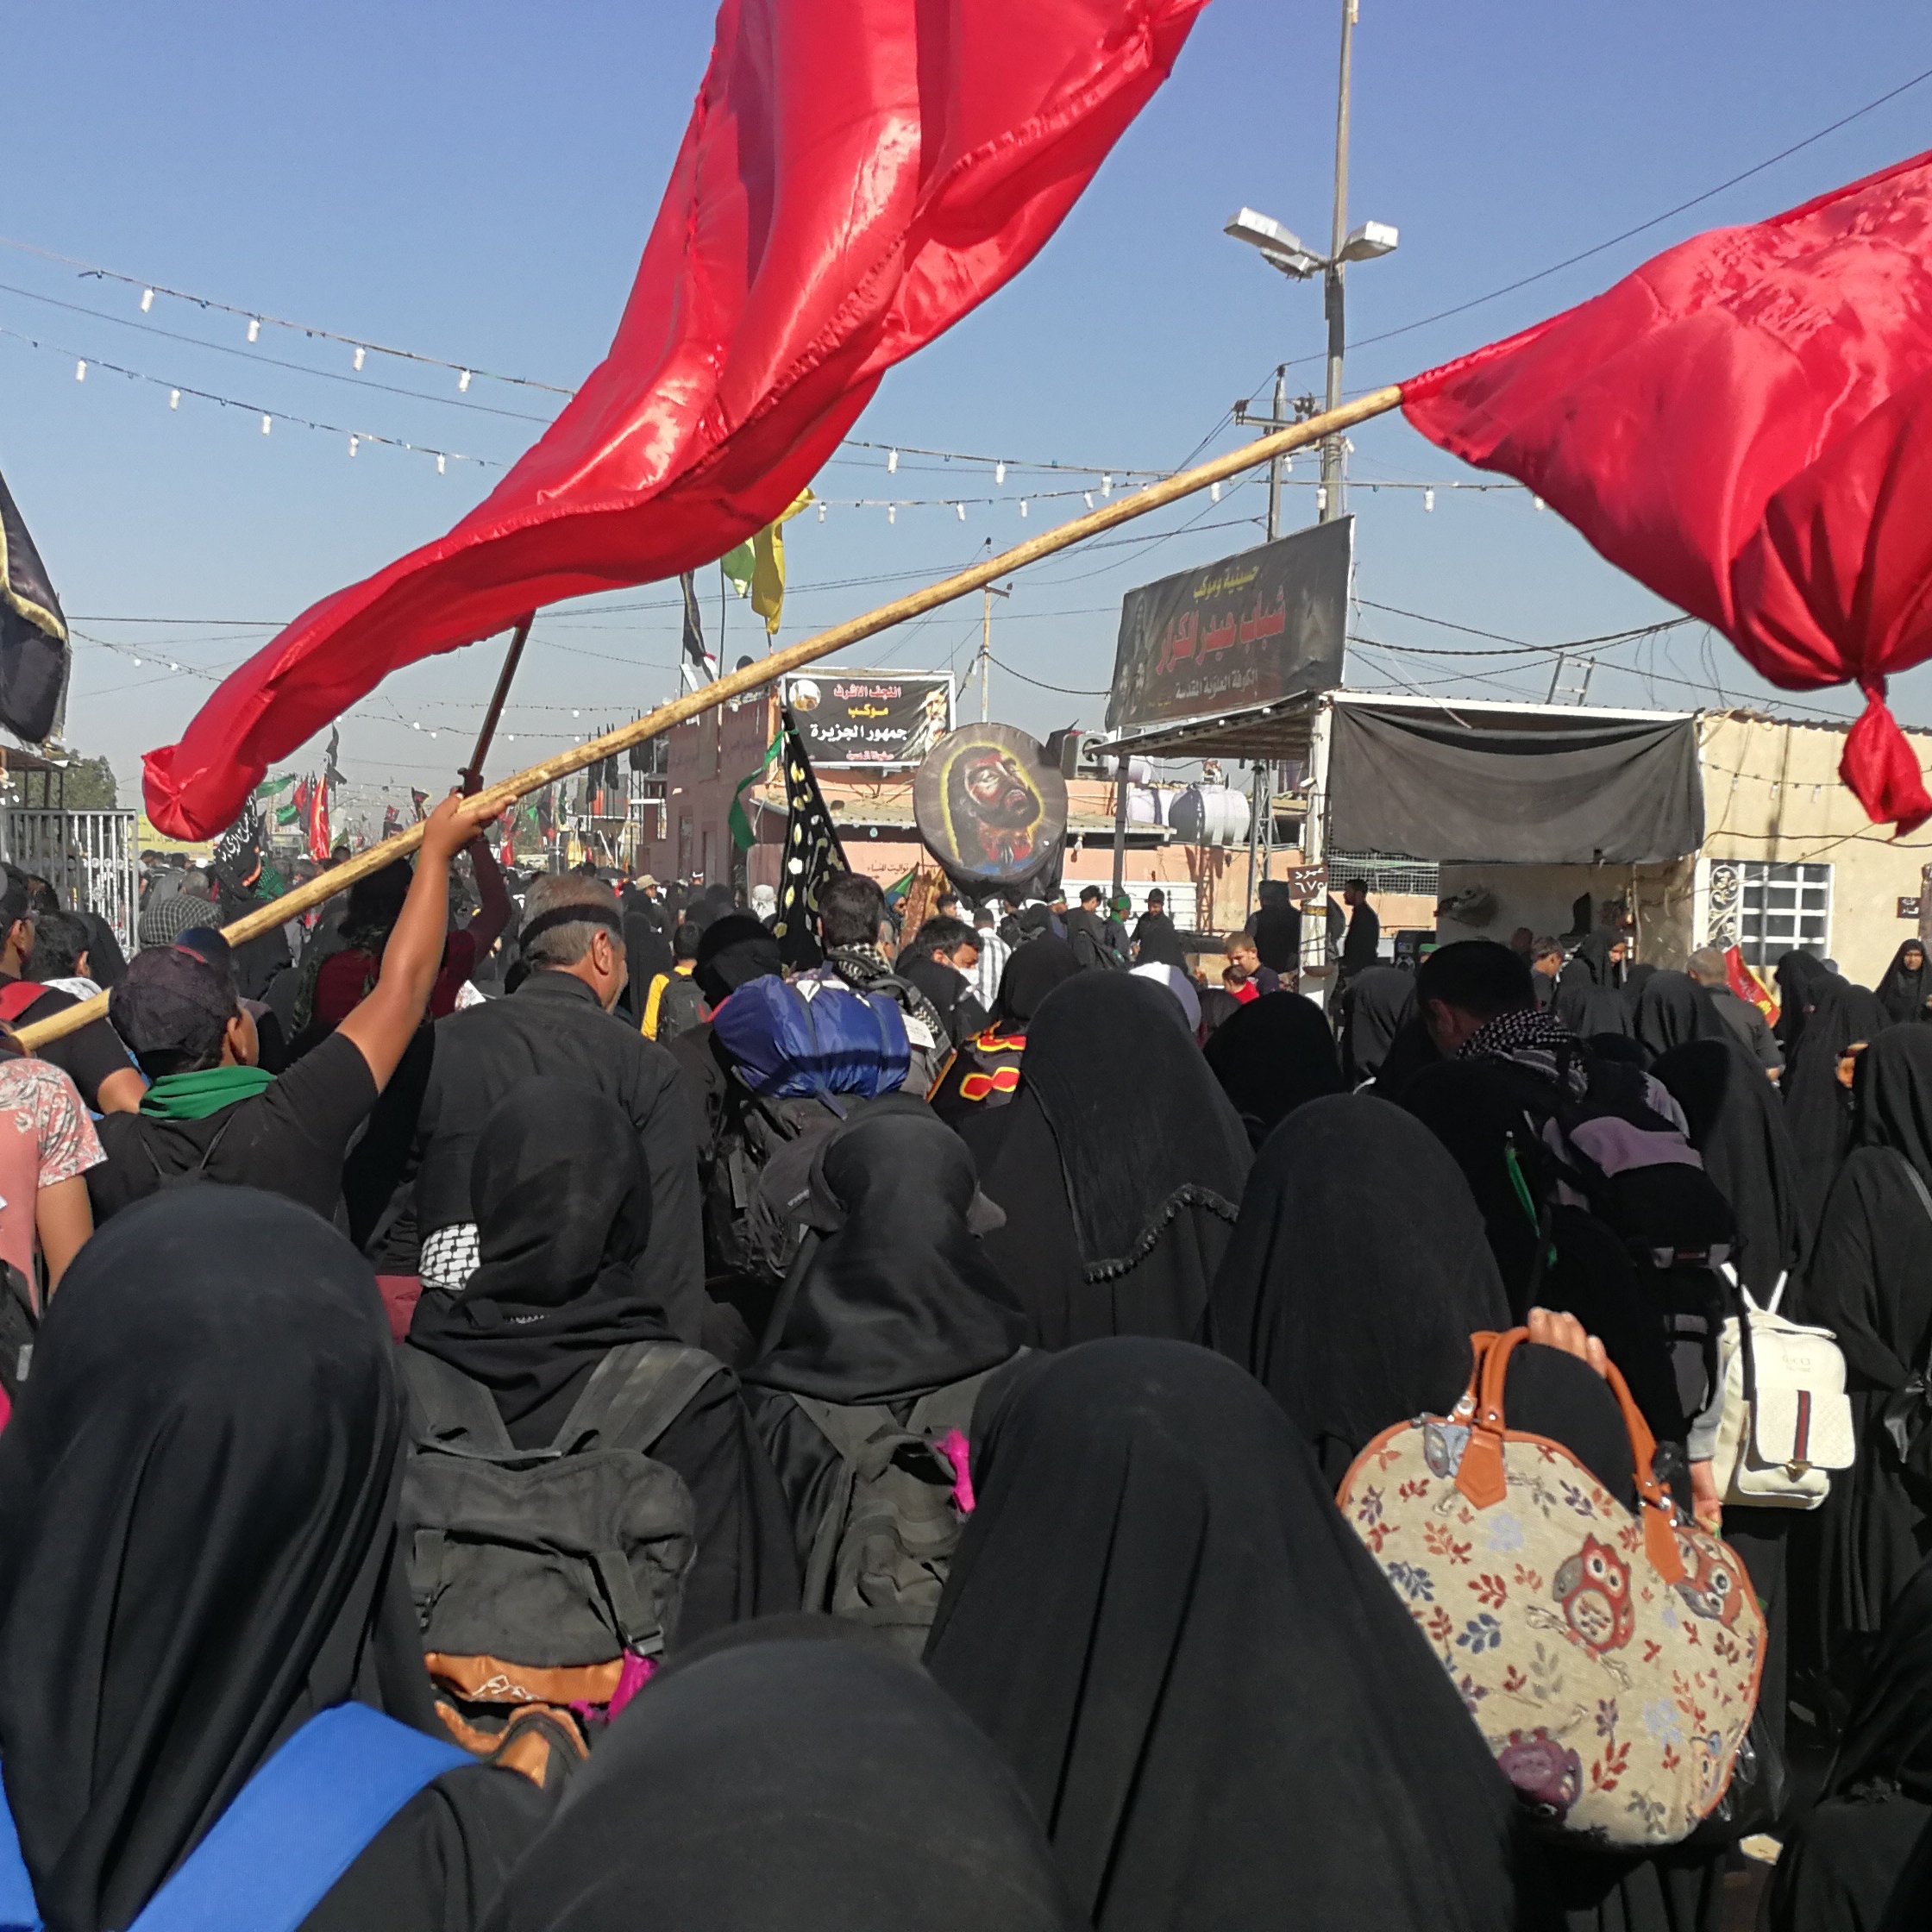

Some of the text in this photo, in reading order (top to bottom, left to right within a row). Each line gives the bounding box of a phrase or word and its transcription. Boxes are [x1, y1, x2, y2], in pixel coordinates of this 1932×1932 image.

[1156, 610, 1200, 676] الكرار
[1195, 612, 1237, 667] حيدر
[869, 684, 902, 700] النجف
[848, 703, 889, 718] موكب
[810, 723, 907, 742] جمهور الجزيرة
[1295, 868, 1324, 879] عمود
